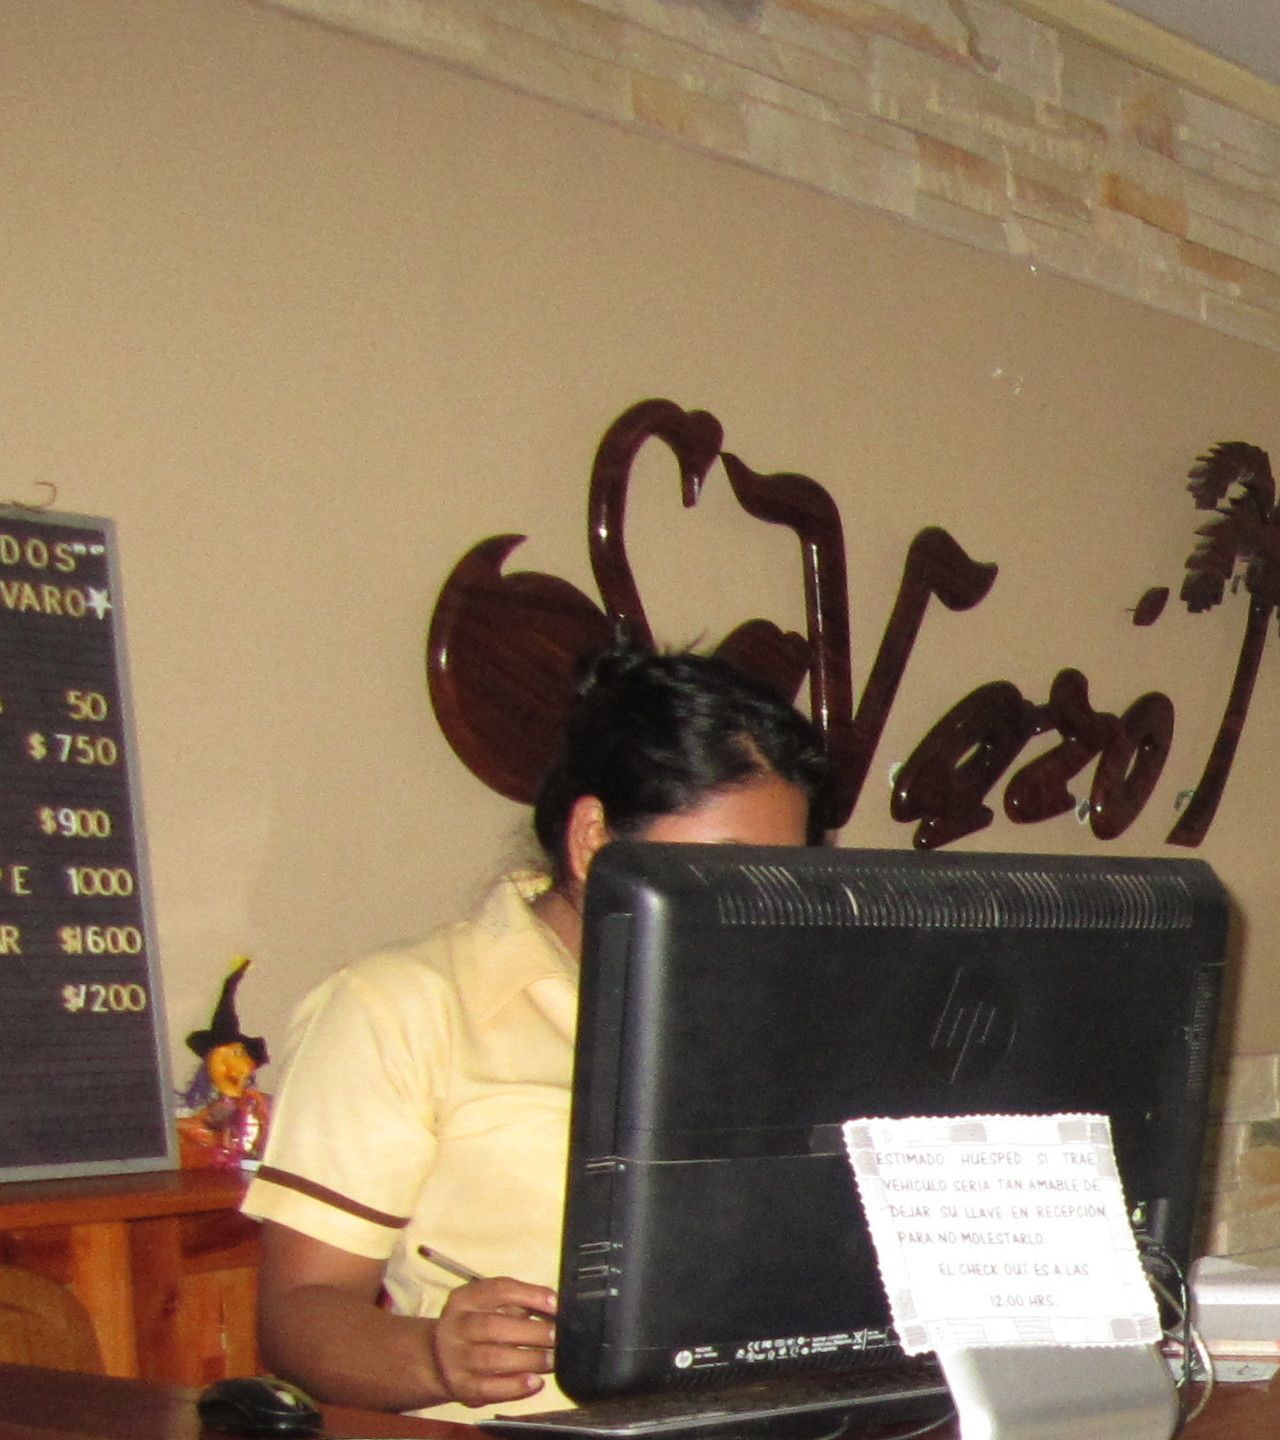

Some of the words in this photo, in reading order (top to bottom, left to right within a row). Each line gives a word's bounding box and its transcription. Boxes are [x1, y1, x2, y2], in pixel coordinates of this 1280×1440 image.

[66, 689, 109, 722] 50
[65, 867, 134, 897] 1000
[876, 1151, 945, 1166] ESTIMADO
[960, 1151, 1022, 1166] HUESPED
[1036, 1151, 1049, 1166] SI
[1063, 1151, 1097, 1166] TRAE
[882, 1179, 947, 1193] VEHICULO
[952, 1179, 991, 1193] SERIA
[996, 1178, 1023, 1191] TAN
[1028, 1178, 1079, 1193] AMABLE
[1083, 1178, 1102, 1192] DE
[889, 1203, 931, 1220] DEJAR
[939, 1204, 958, 1220] SU
[965, 1205, 1004, 1219] LLAVE
[1011, 1205, 1030, 1219] EN
[897, 1230, 933, 1247] PARA
[937, 1231, 957, 1245] NO
[960, 1231, 1044, 1246] MOLESTARLO
[939, 1262, 955, 1276] EL
[958, 1262, 999, 1277] CHECK
[1003, 1262, 1030, 1276] OUT
[1033, 1262, 1050, 1277] ES
[1054, 1263, 1062, 1276] A
[1065, 1262, 1090, 1276] LAS
